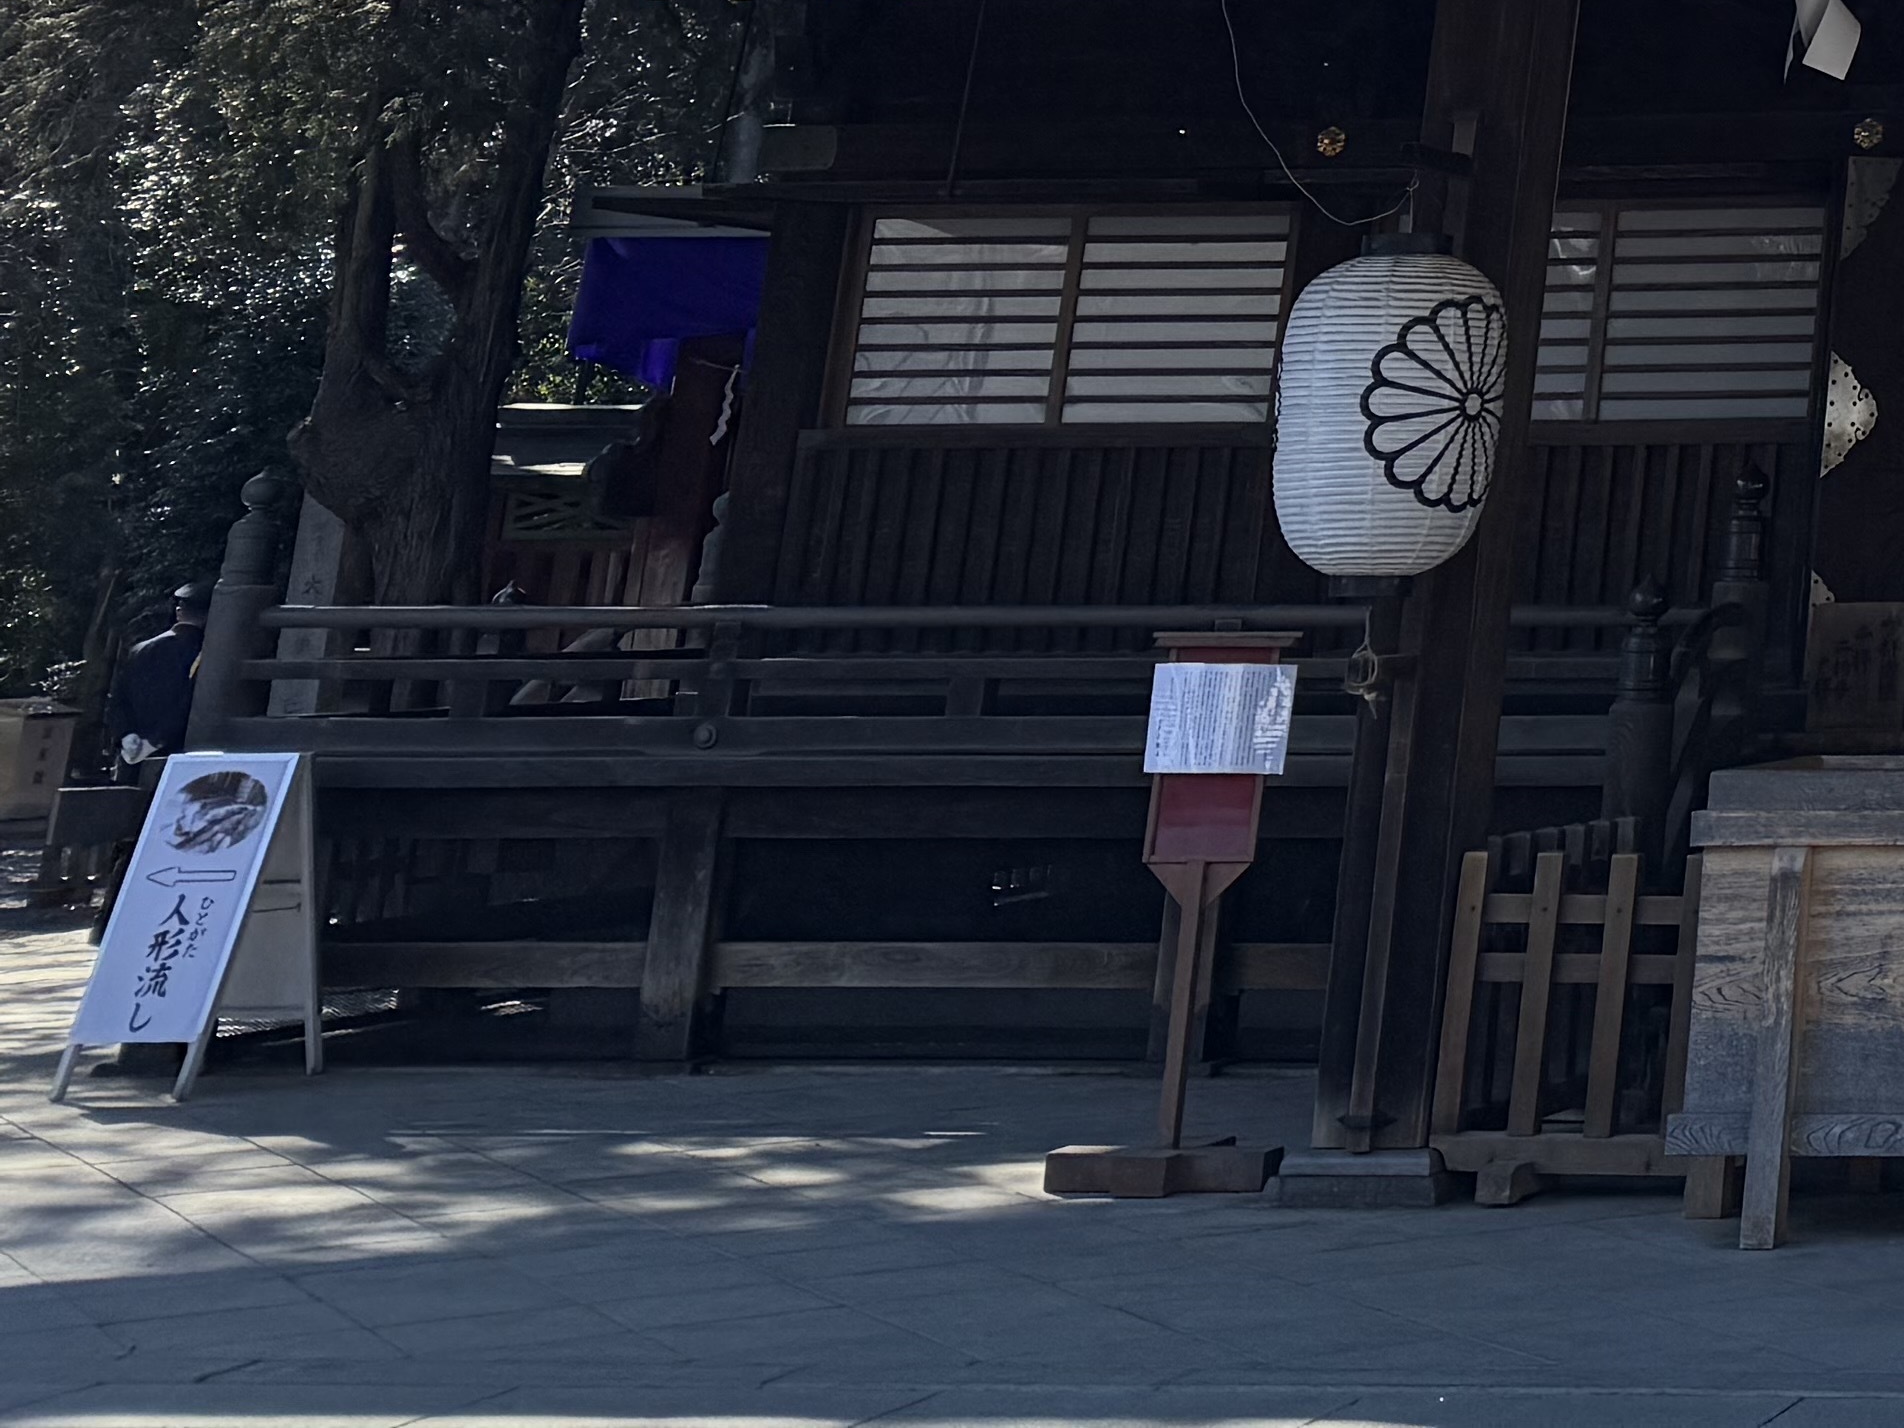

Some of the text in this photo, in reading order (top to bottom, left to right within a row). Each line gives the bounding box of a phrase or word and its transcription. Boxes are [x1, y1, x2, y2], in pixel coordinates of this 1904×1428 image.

[129, 893, 190, 1033] 人形流し
[182, 897, 215, 959] ひとがた
